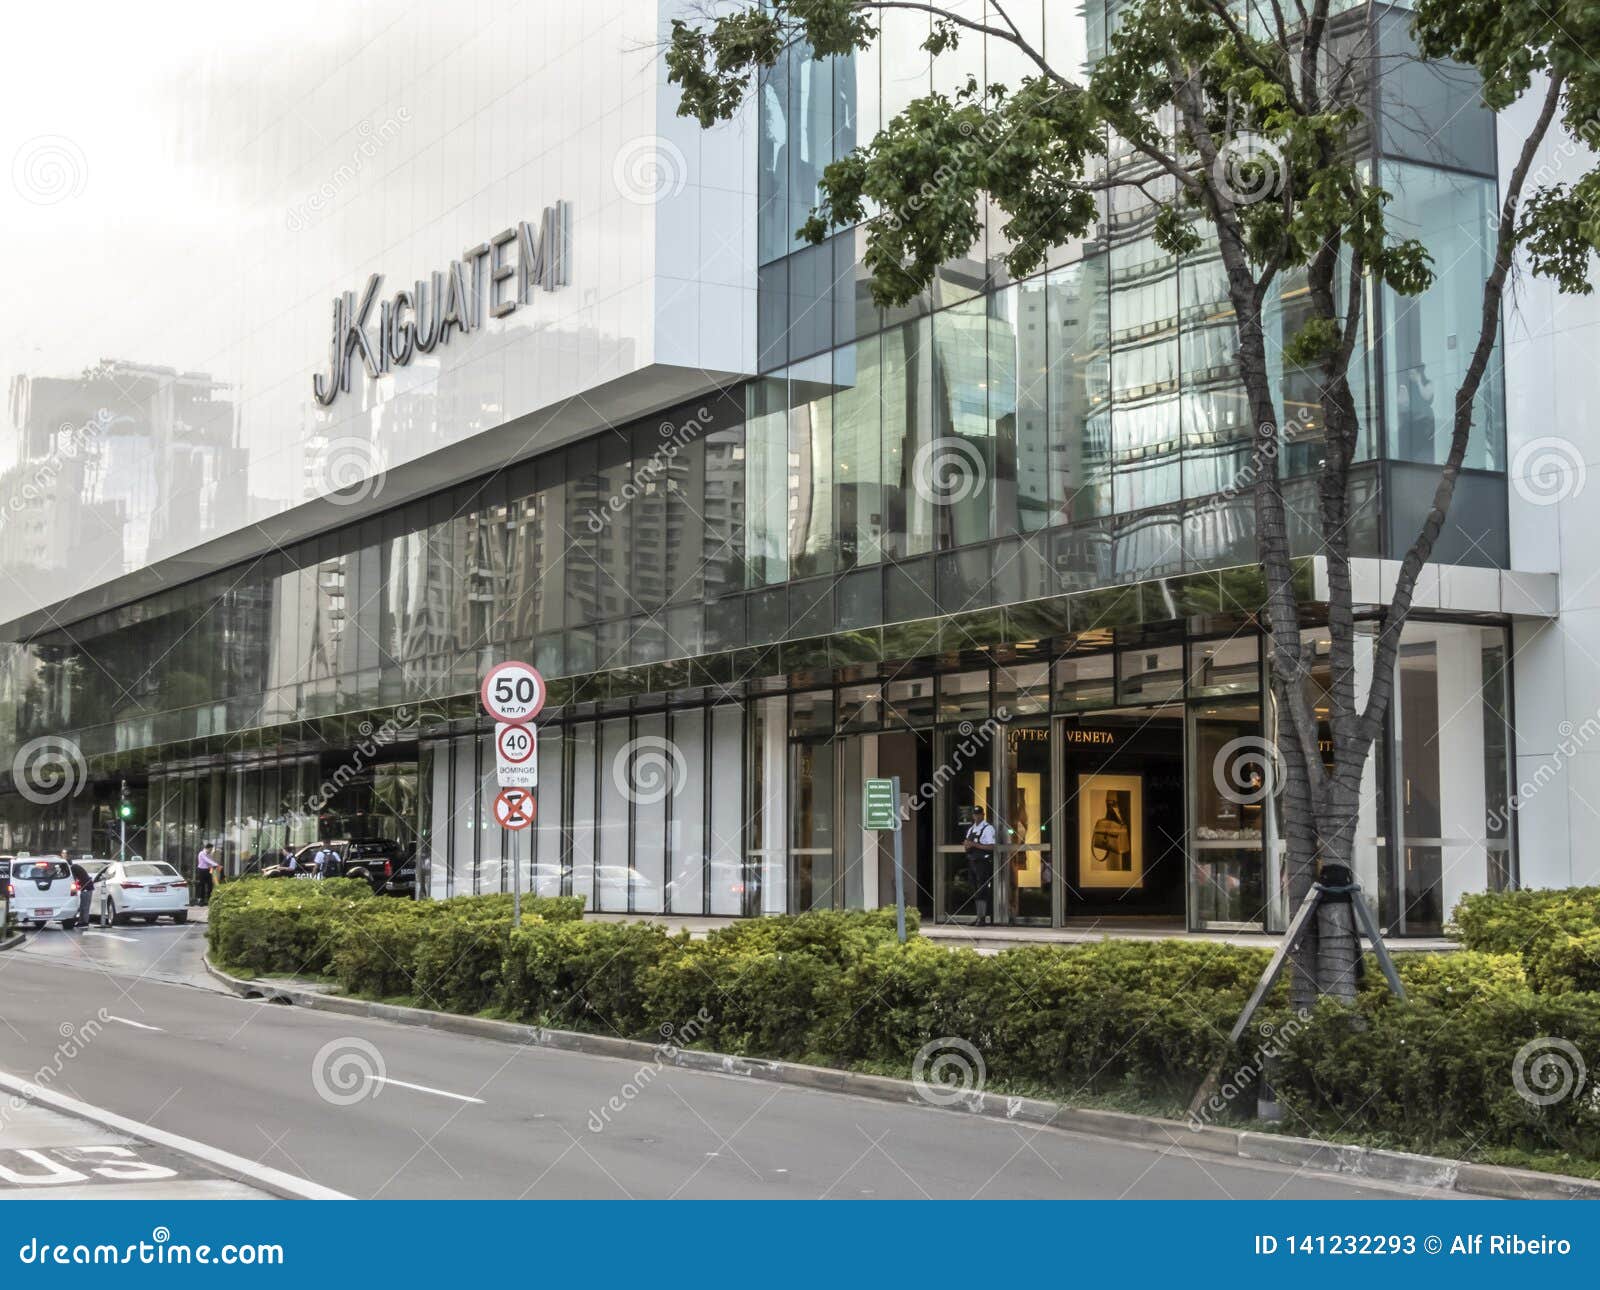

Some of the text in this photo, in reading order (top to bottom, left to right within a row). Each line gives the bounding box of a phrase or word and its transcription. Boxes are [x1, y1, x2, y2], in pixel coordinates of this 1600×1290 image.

[380, 199, 568, 374] IGUATEMI
[495, 677, 535, 704] 50
[506, 735, 528, 750] 40
[1066, 730, 1114, 744] VENETA
